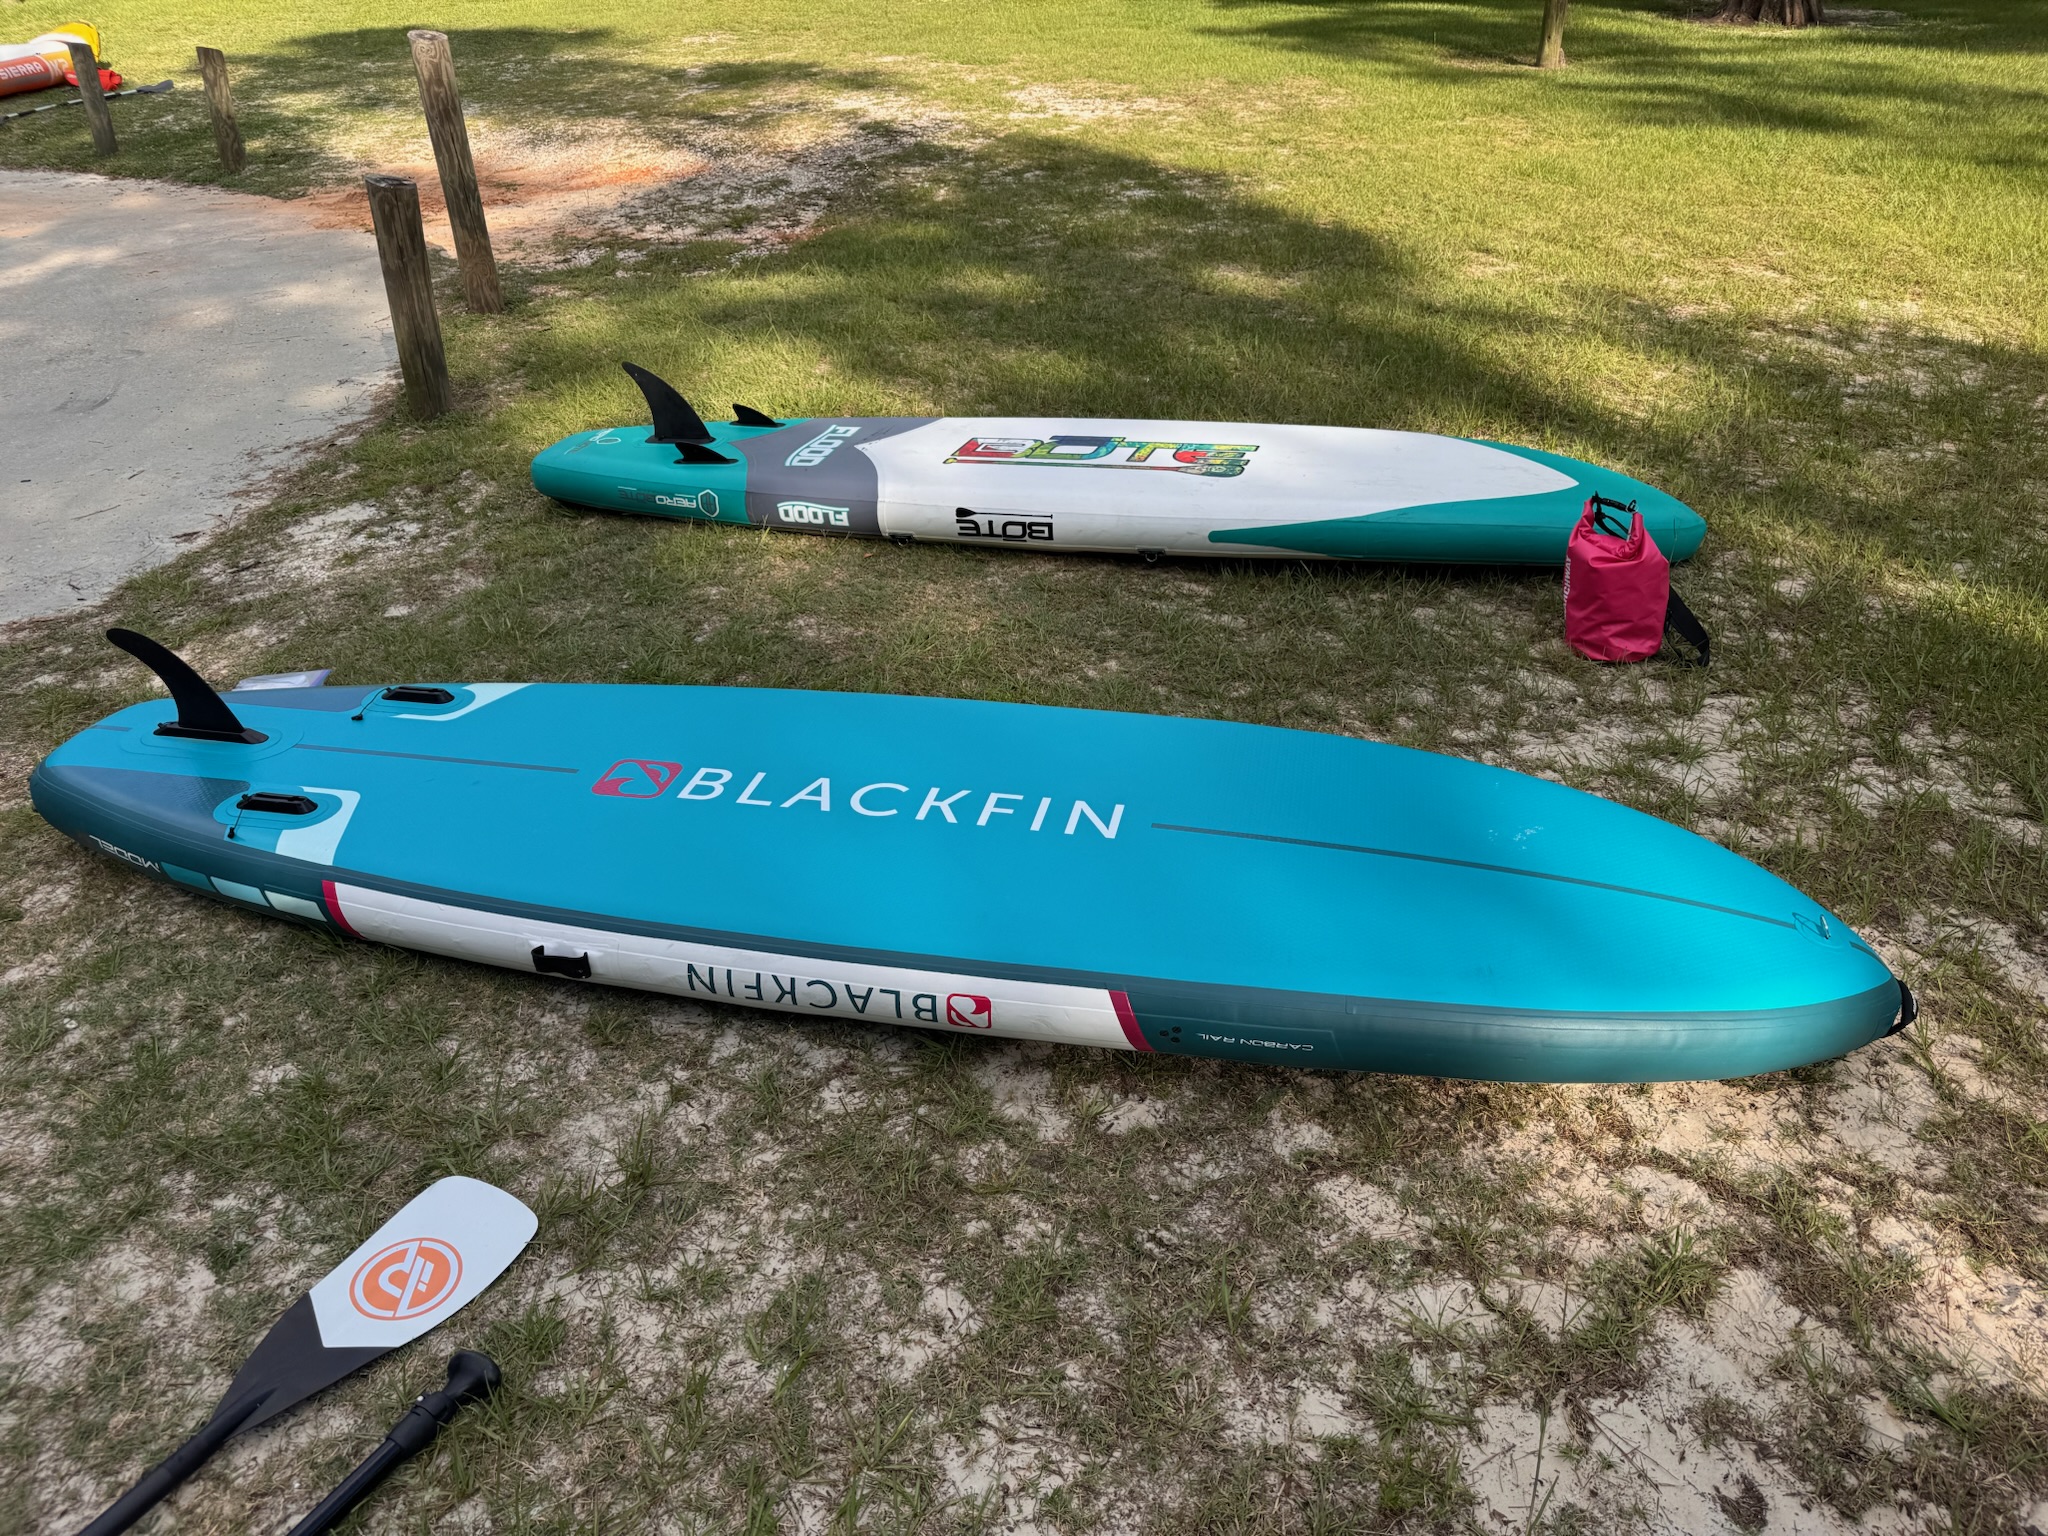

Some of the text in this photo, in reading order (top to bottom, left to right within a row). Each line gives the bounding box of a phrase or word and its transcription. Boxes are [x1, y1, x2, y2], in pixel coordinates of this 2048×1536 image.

[0, 61, 45, 80] SIERRA
[790, 425, 862, 467] FLOOD
[778, 504, 850, 527] FLOOD
[1563, 554, 1573, 618] CHWAY
[677, 766, 1126, 839] BLACKFIN
[88, 834, 161, 873] MODEL
[686, 962, 940, 1025] BLACKFIN
[1195, 1032, 1314, 1052] CARBON RAIL
